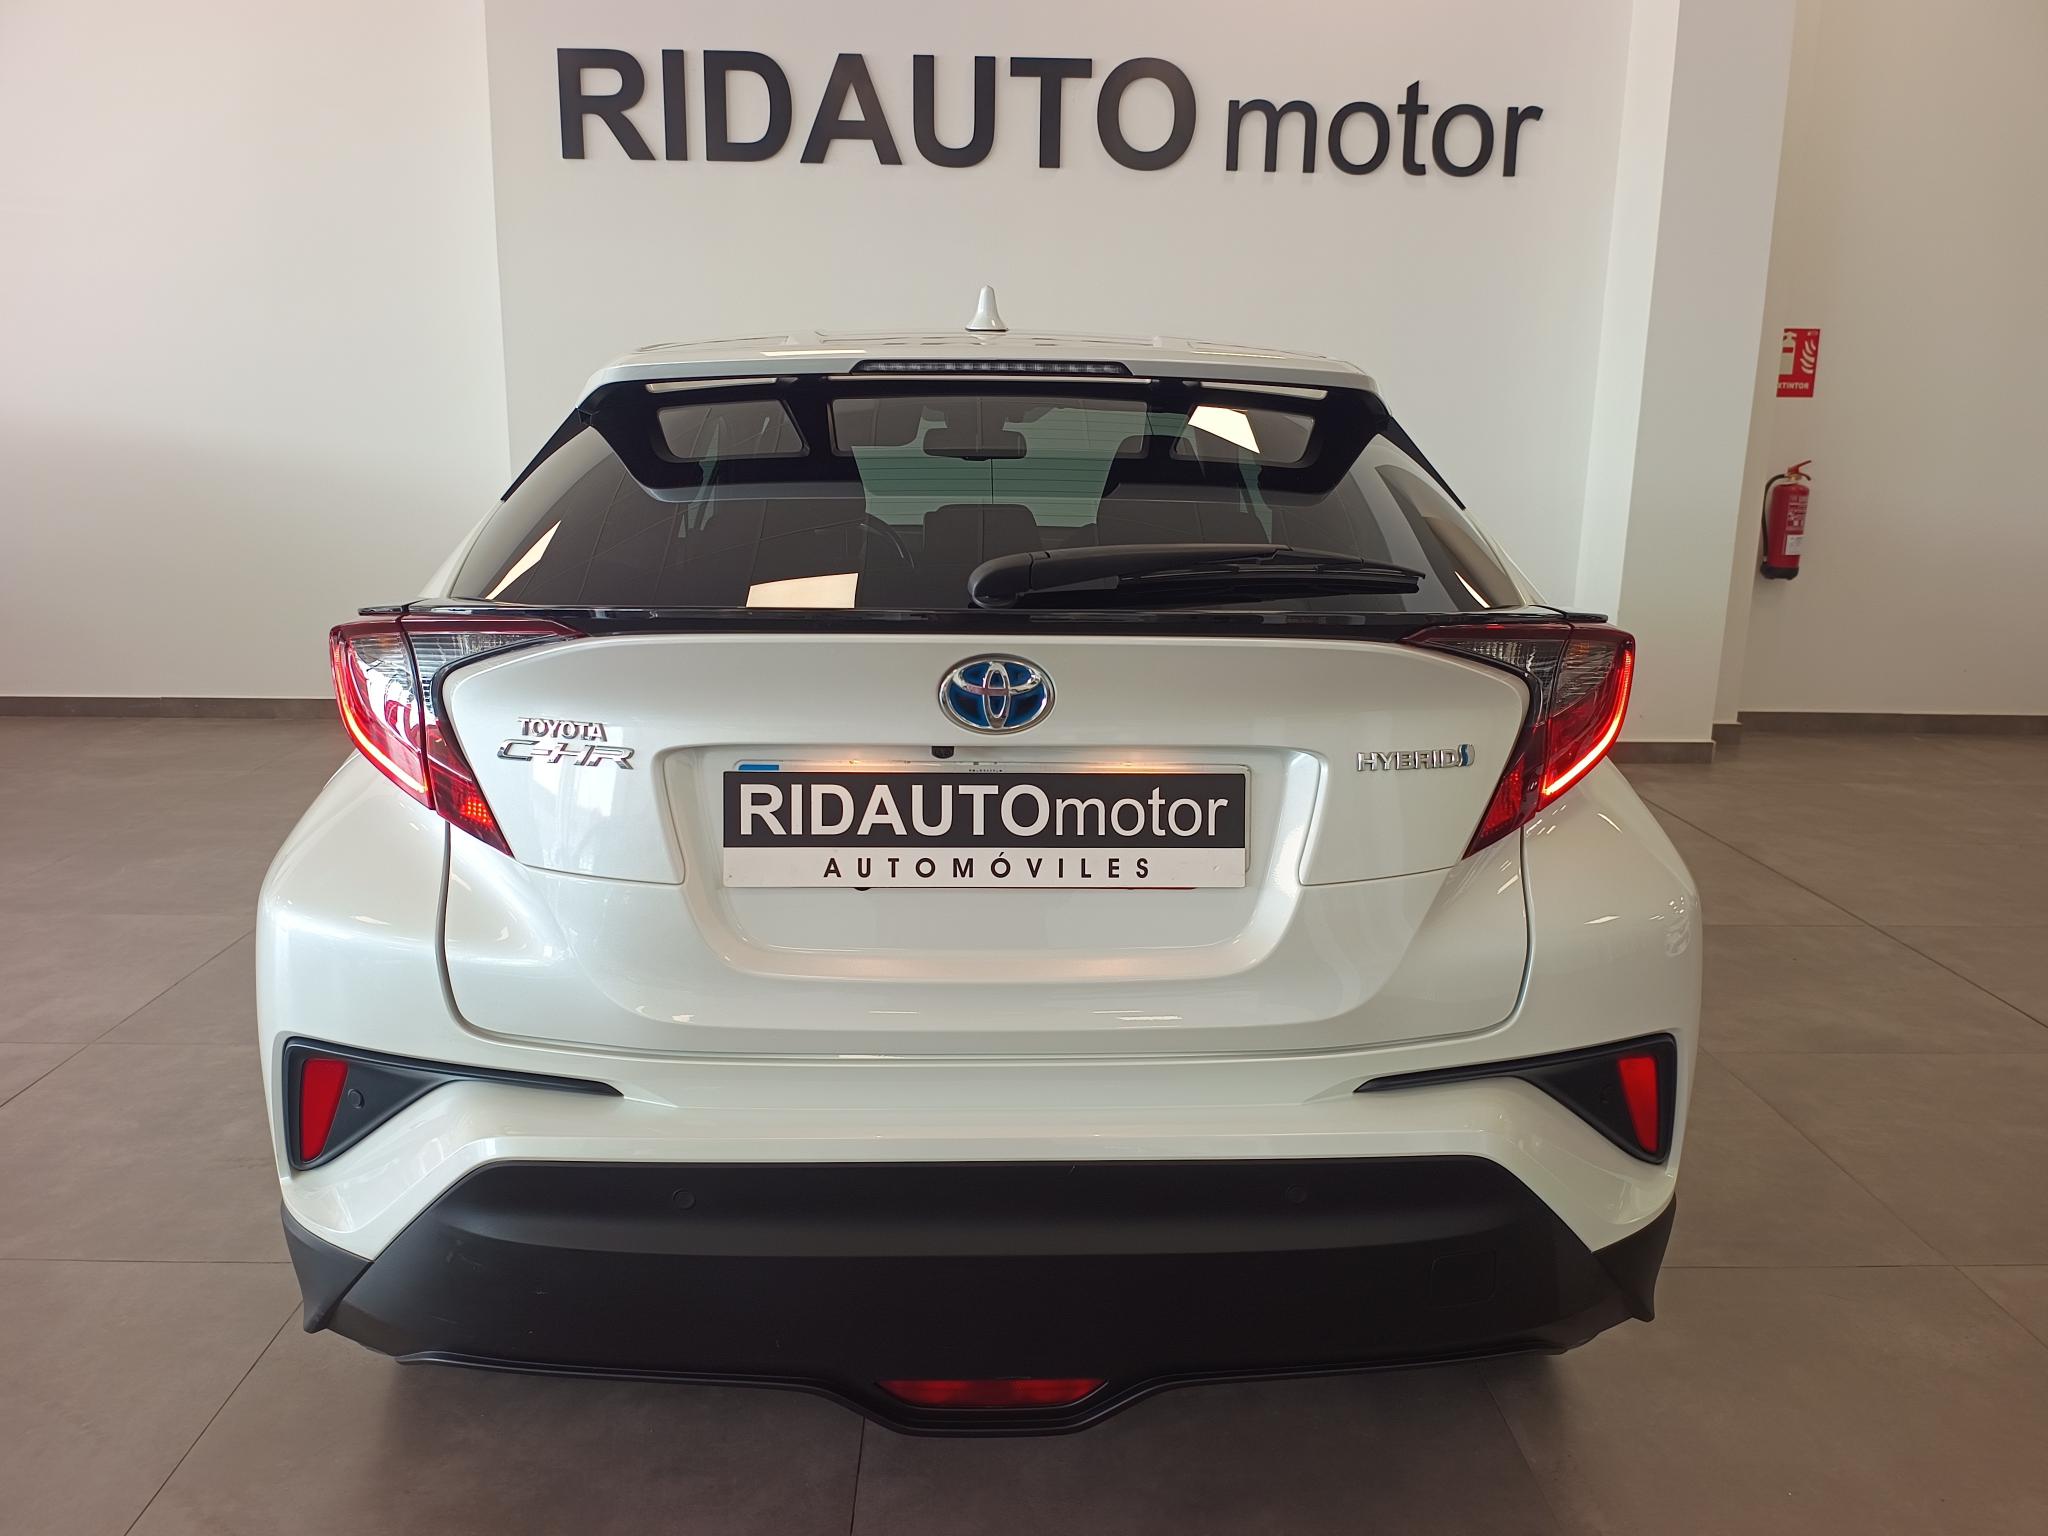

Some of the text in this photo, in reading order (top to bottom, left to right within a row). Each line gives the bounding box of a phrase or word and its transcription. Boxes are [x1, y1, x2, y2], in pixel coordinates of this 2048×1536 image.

[556, 48, 1545, 178] RIDAUTO motor
[518, 717, 608, 742] TOYOTA
[497, 739, 634, 770] C-HR
[1357, 750, 1459, 771] HYBRID
[739, 784, 1229, 837] RIDAUTOmotor
[823, 852, 1150, 879] AUTOMÓVILES
